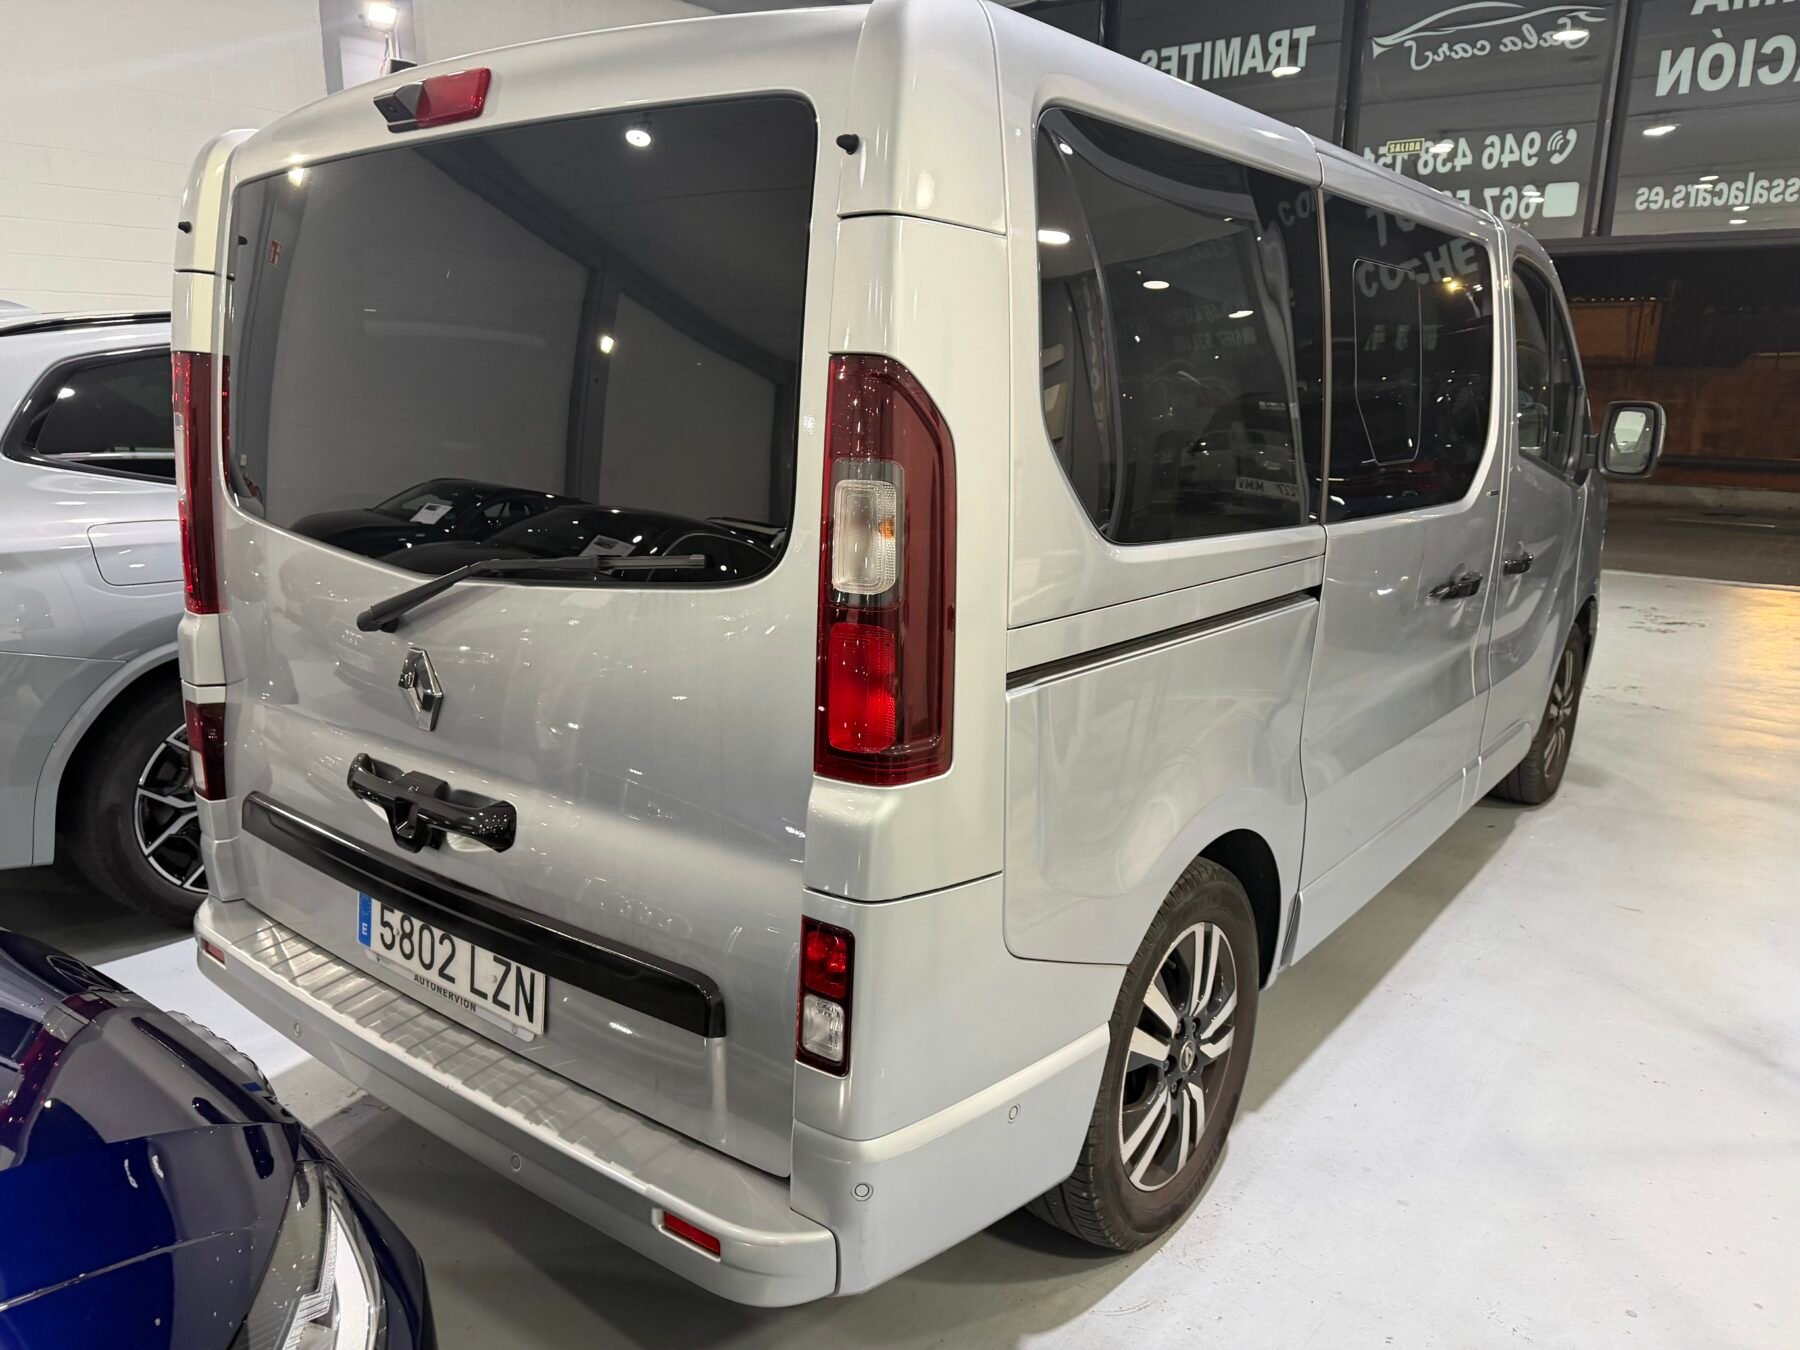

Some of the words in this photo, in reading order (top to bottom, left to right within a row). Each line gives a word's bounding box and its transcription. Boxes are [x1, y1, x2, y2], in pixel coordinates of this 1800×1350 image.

[1389, 140, 1422, 154] SALIDA
[1355, 237, 1480, 298] COCHE
[361, 922, 369, 936] E
[379, 904, 456, 985] 5802
[469, 943, 536, 1024] LZN
[413, 974, 477, 1013] AUTONERVION
